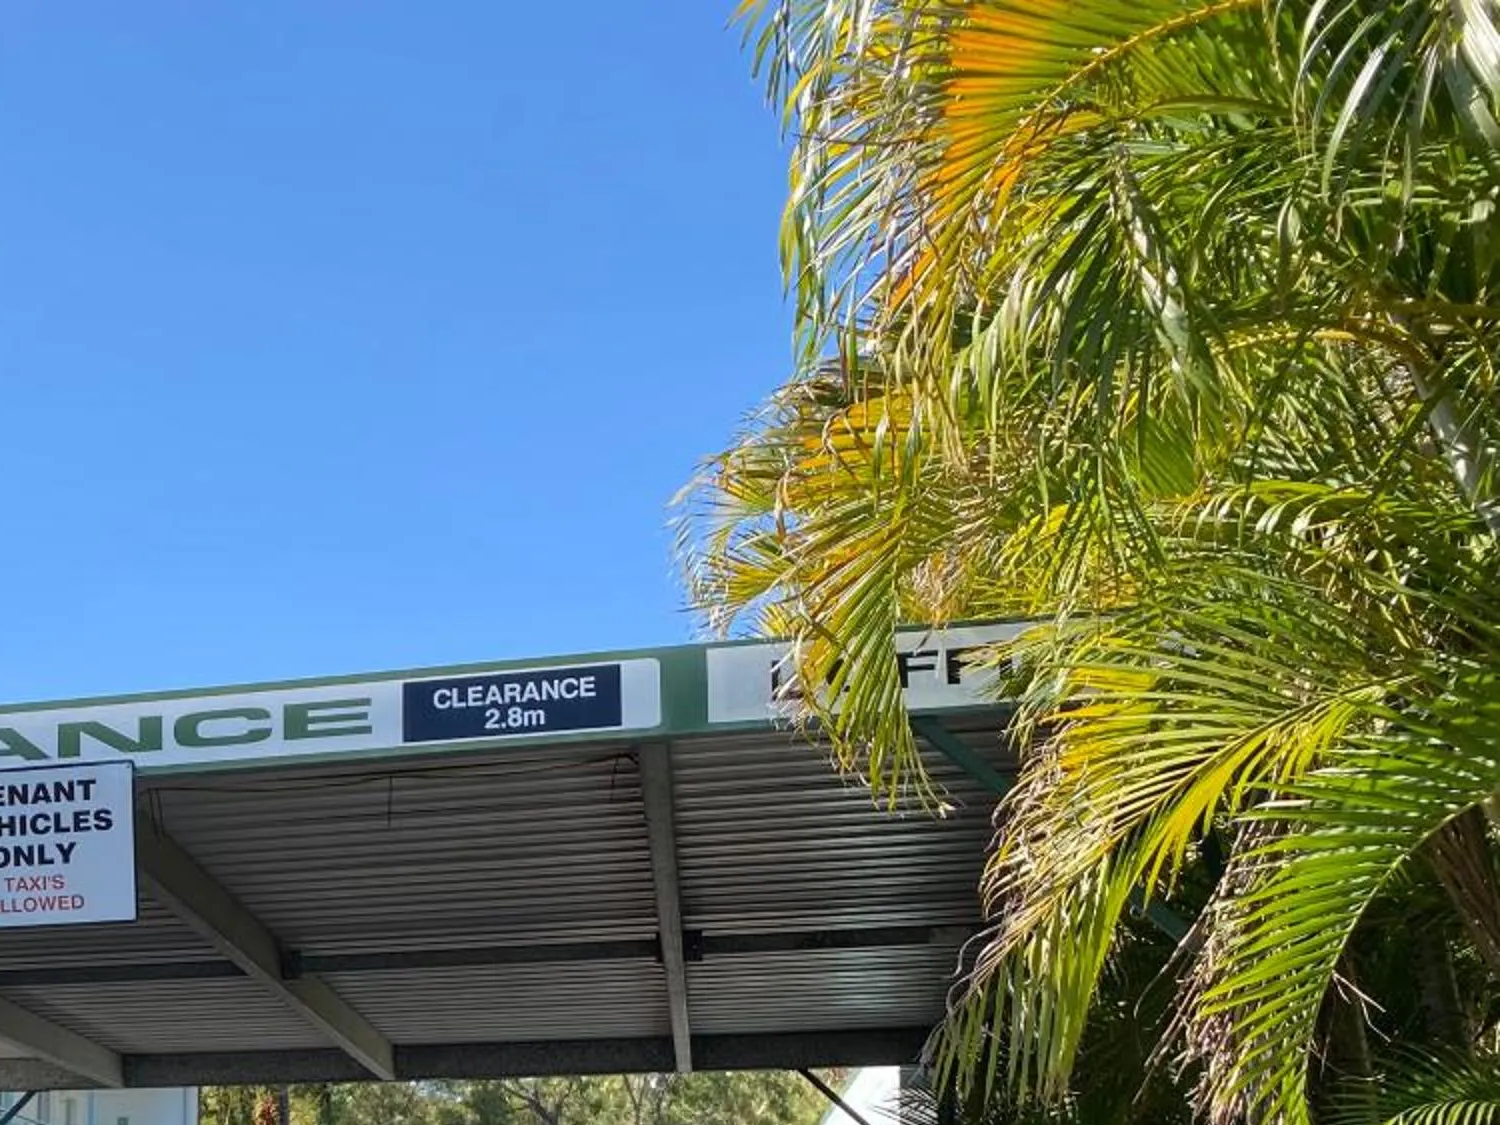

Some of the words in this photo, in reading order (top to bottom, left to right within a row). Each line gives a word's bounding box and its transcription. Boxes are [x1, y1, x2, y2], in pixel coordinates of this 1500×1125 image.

[433, 676, 596, 709] CLEARANCE
[484, 707, 546, 729] 2.8m
[4, 874, 65, 893] TAXI'S
